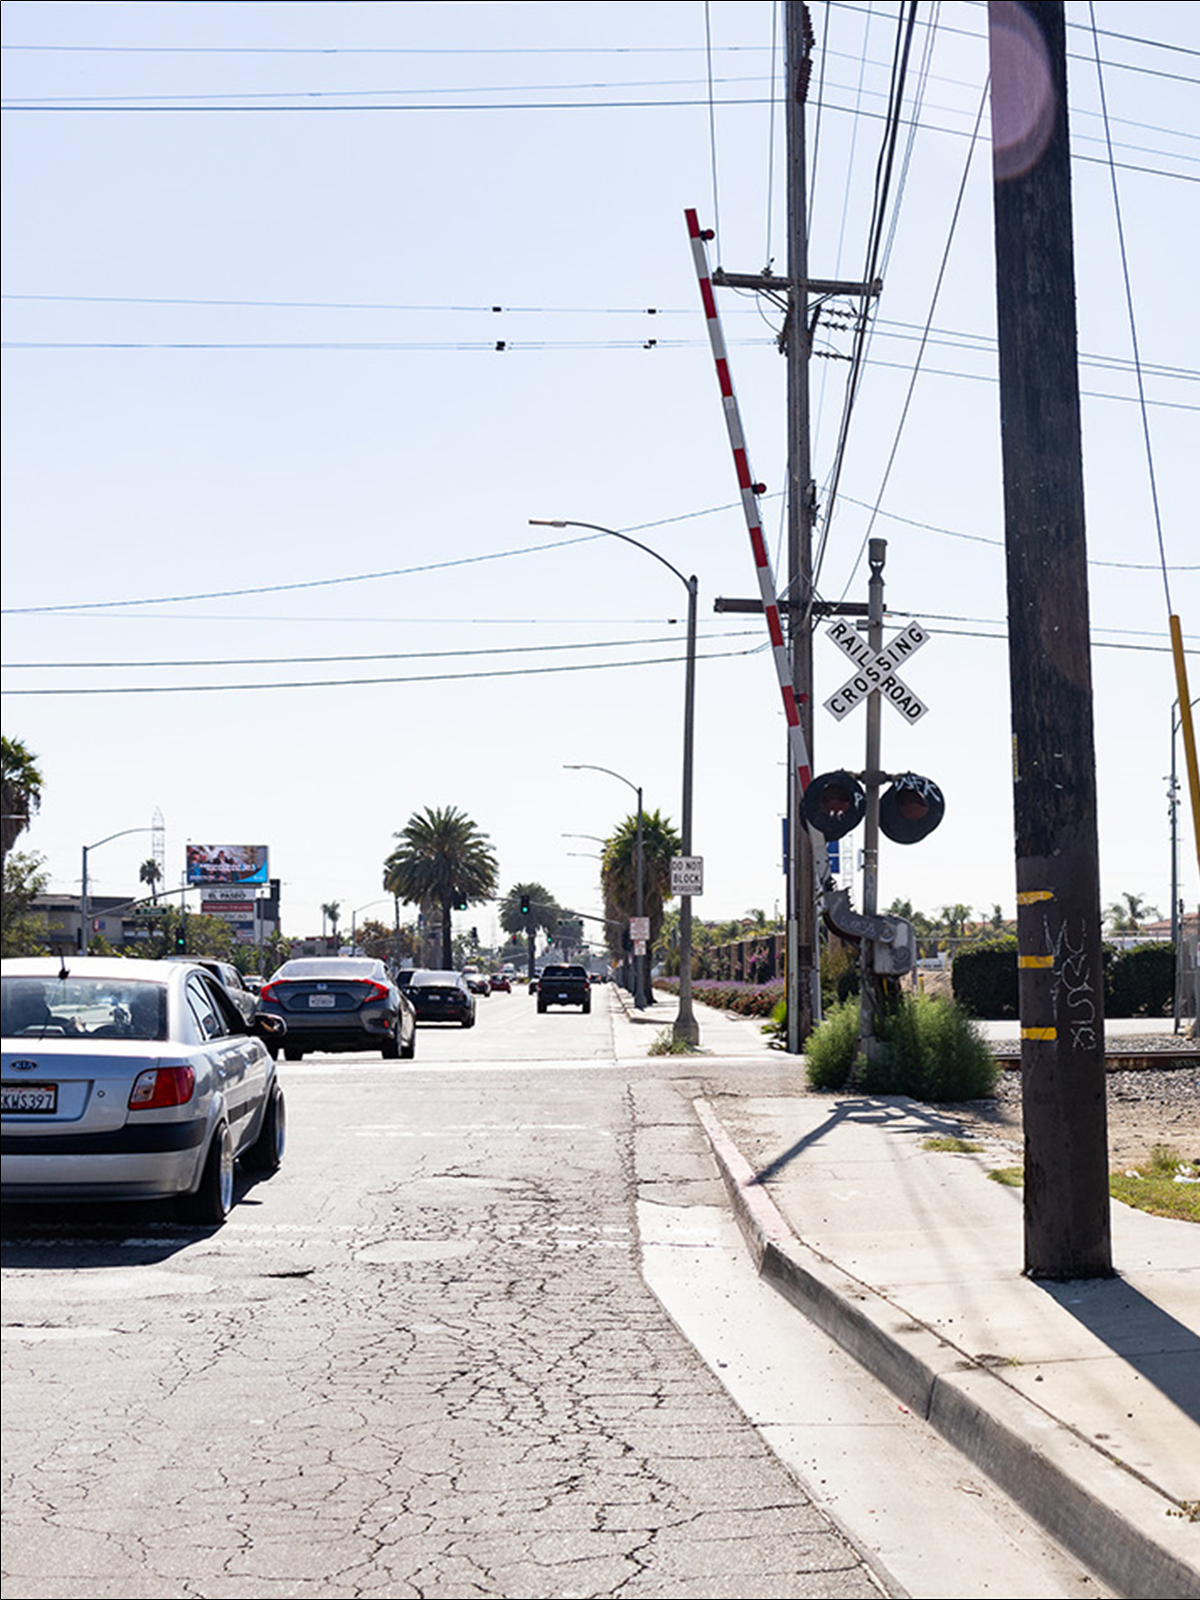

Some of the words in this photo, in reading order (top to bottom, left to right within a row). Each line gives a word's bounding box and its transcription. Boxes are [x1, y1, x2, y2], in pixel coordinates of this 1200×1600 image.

[830, 628, 923, 713] CROSSING
[831, 623, 869, 668] RAIL
[880, 675, 922, 718] ROAD
[672, 861, 683, 870] DO
[685, 861, 701, 870] NOT
[673, 874, 699, 884] BLOCK
